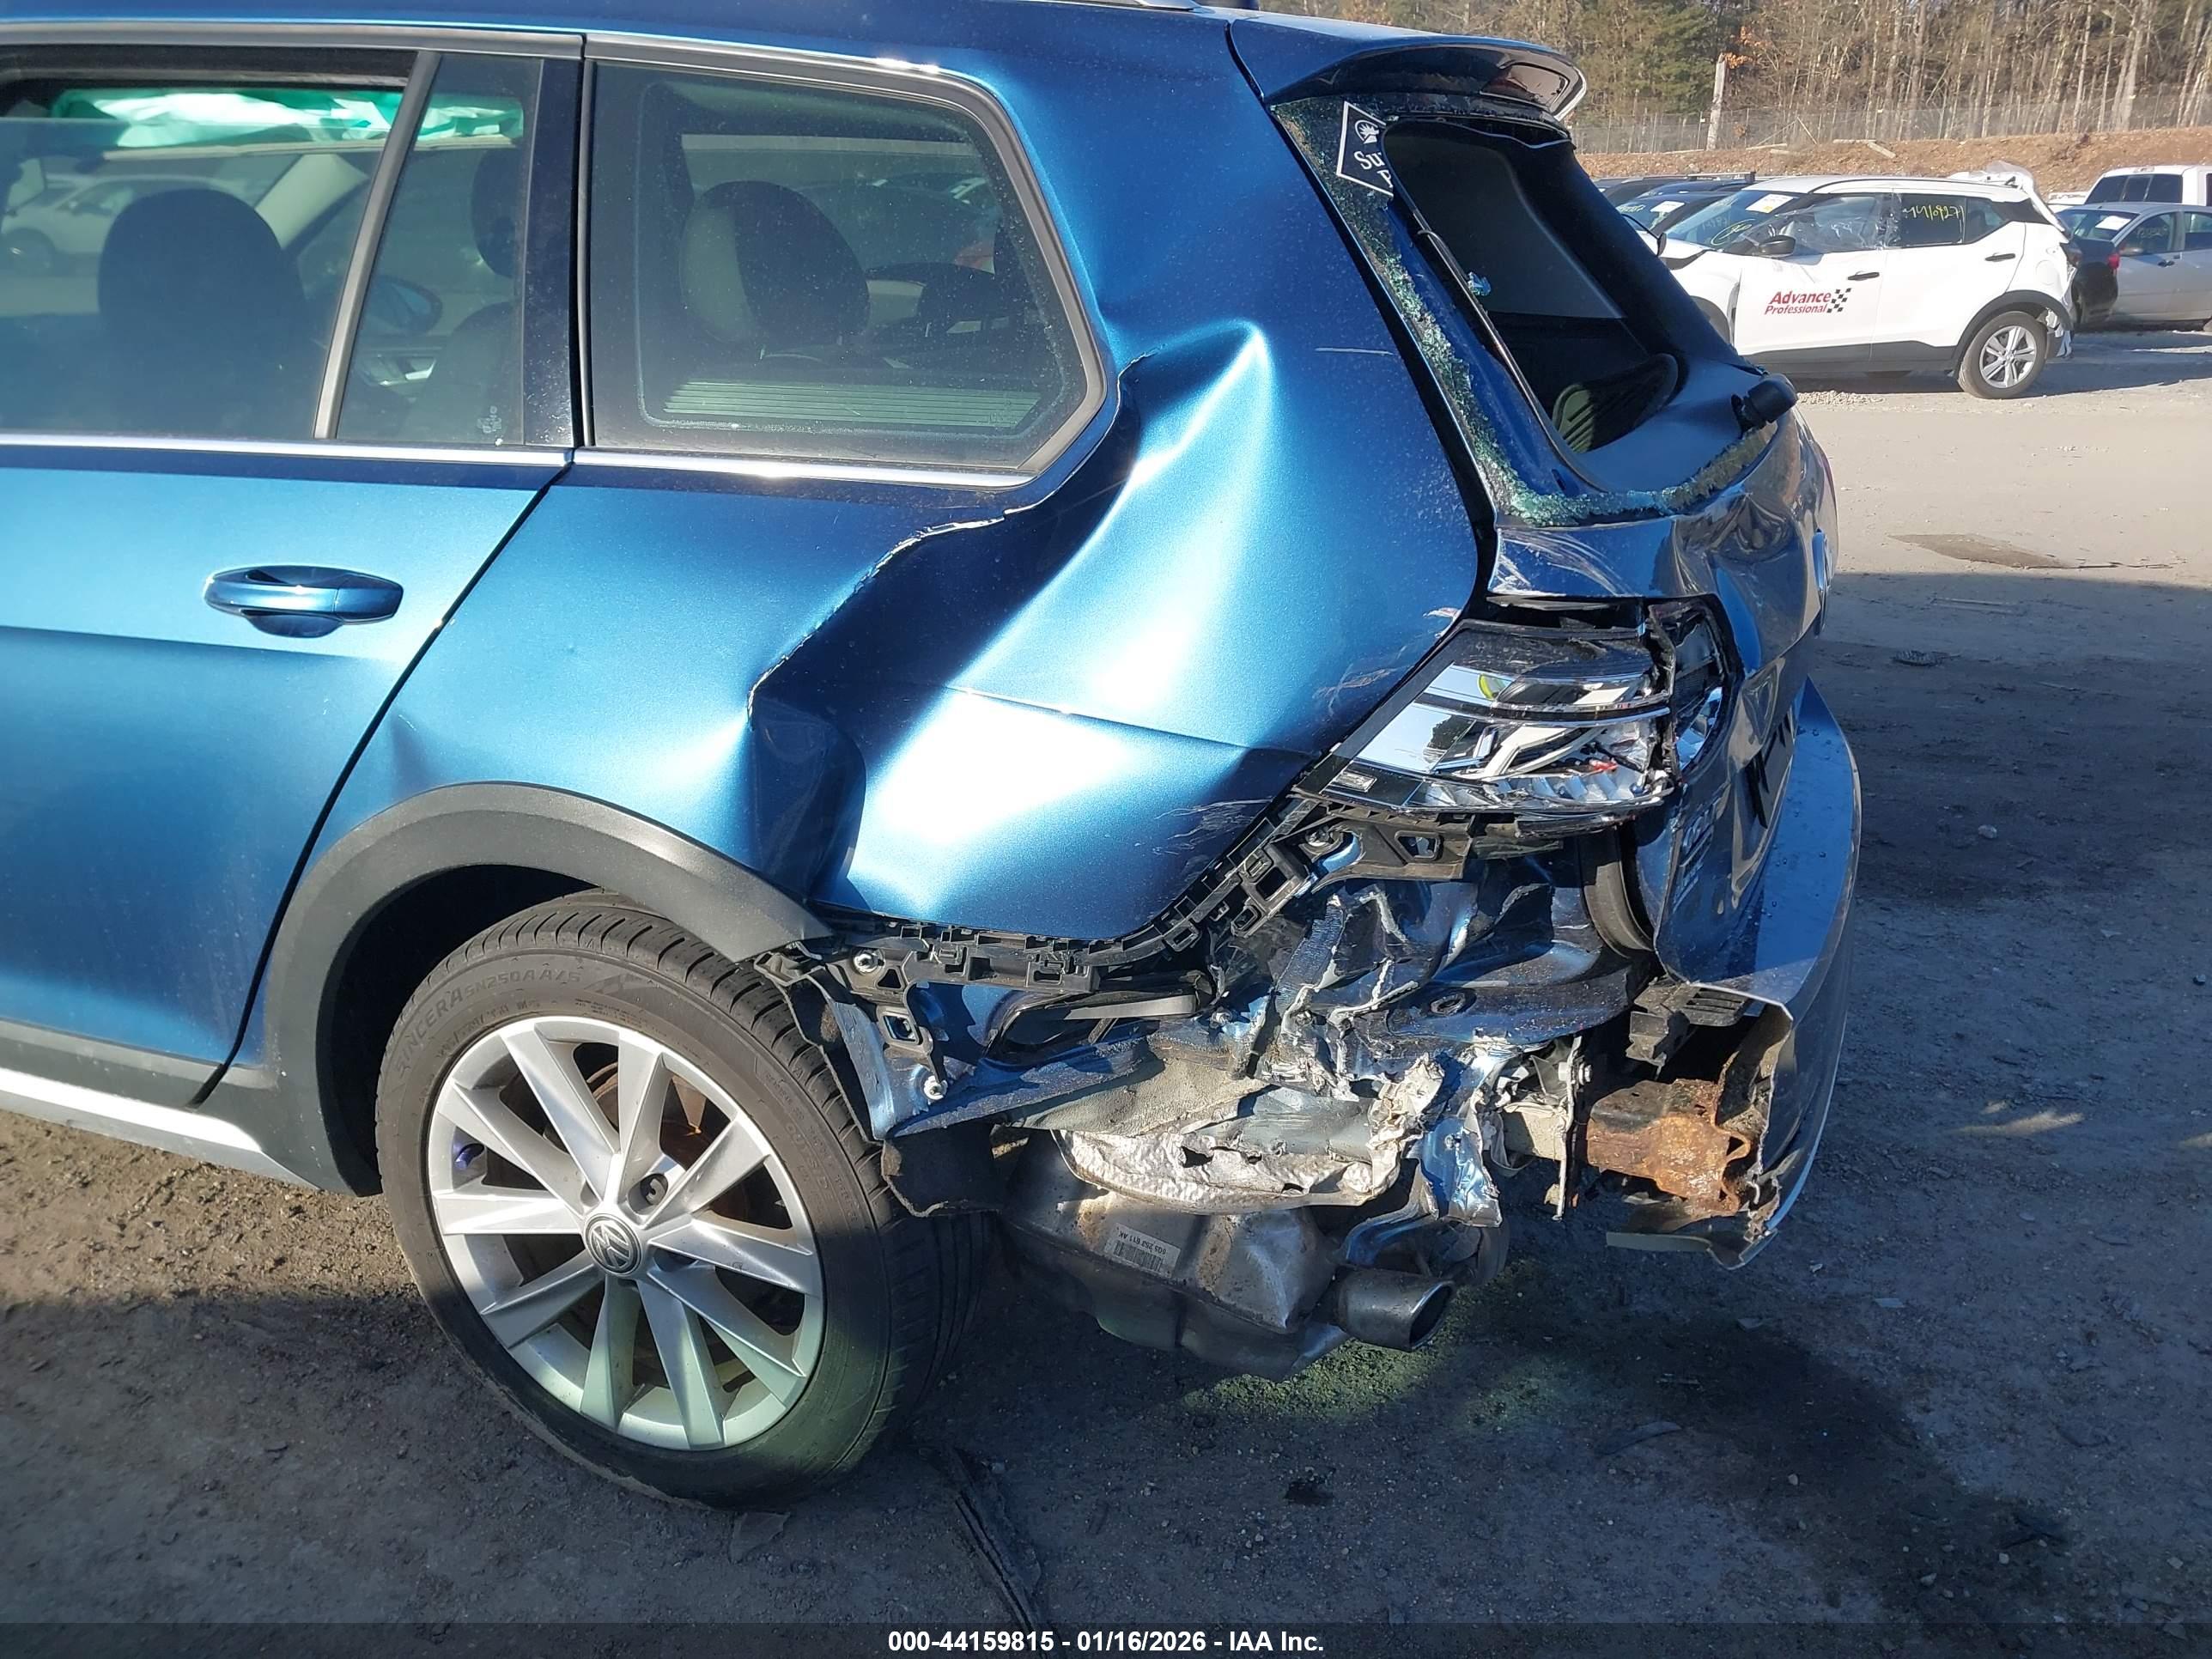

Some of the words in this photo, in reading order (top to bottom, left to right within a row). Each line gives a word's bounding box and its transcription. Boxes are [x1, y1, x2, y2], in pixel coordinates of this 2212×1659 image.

[1769, 290, 1832, 304] Advance
[1765, 303, 1827, 314] Professional
[398, 988, 463, 1079] SINCERA
